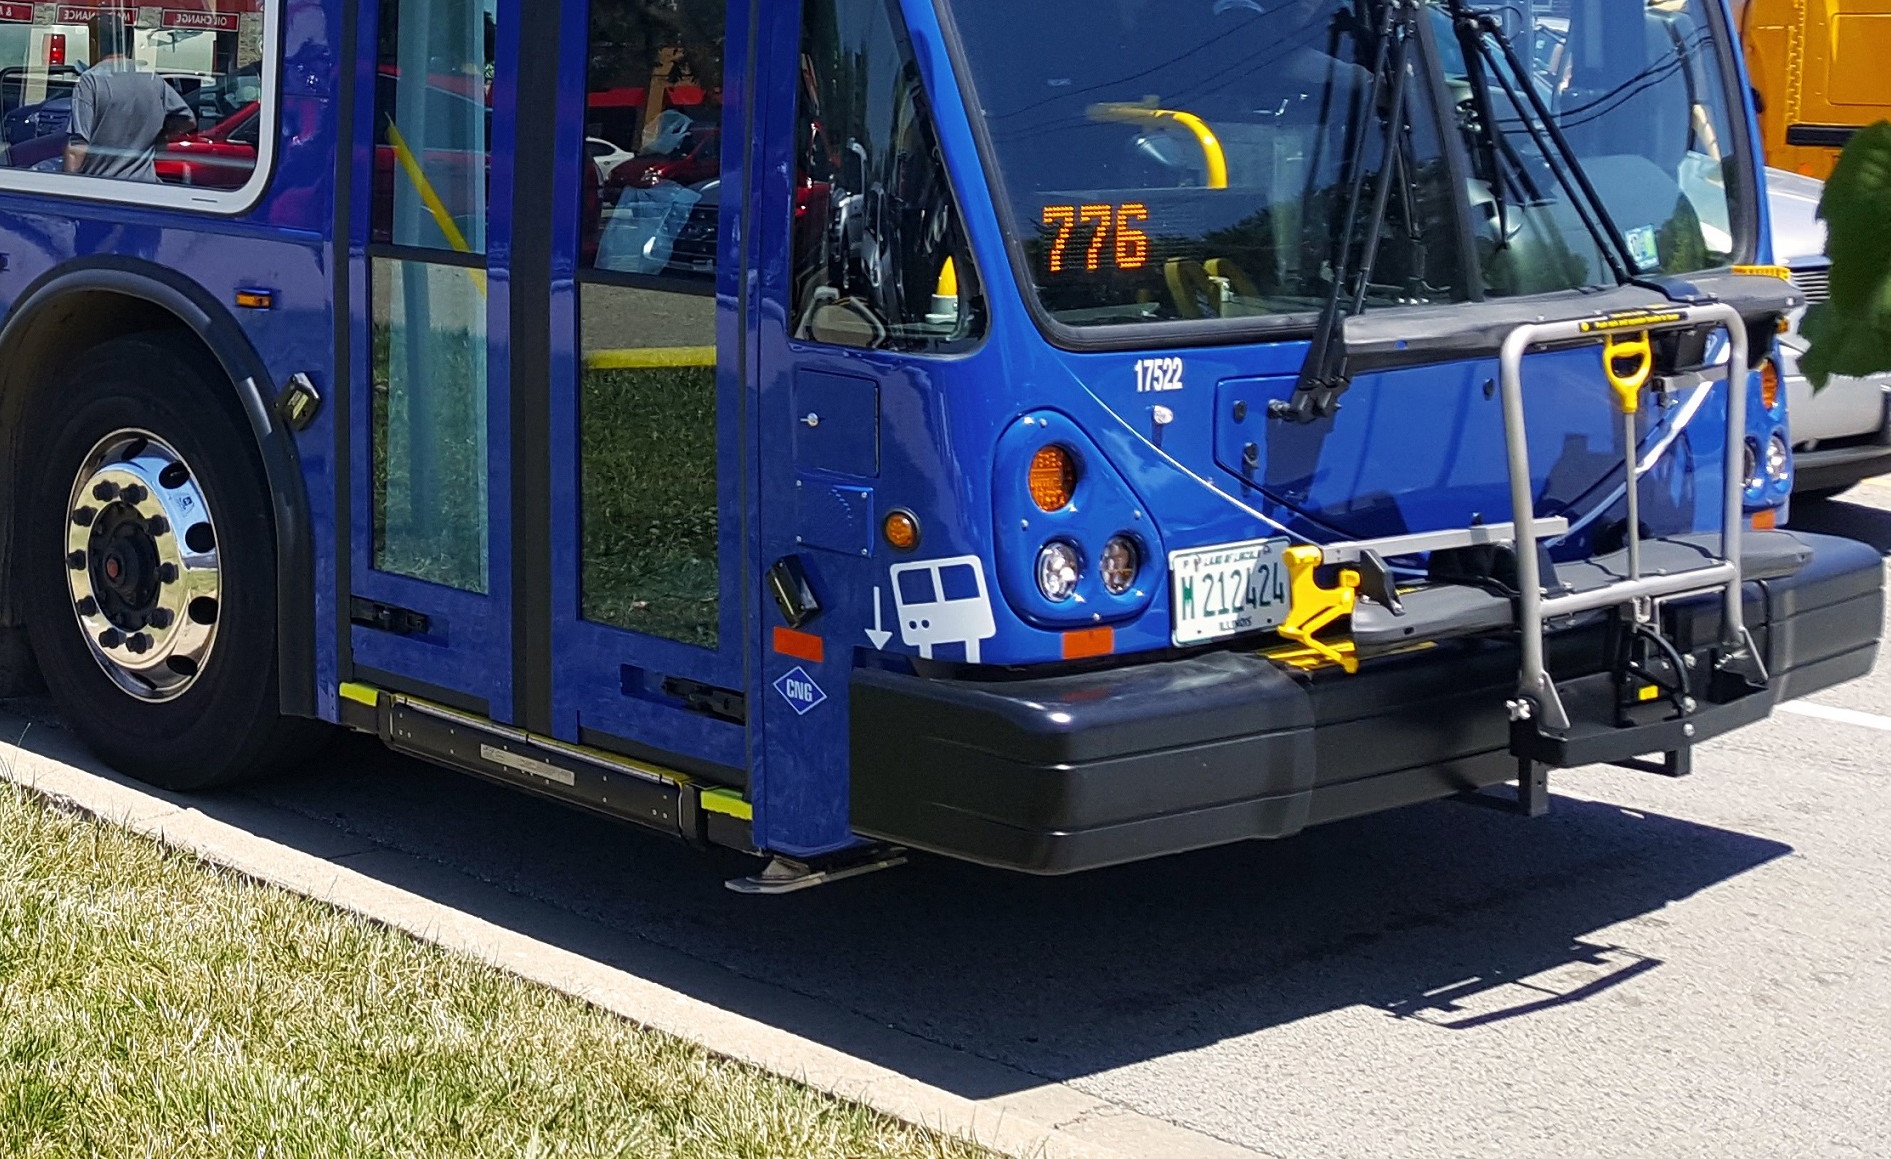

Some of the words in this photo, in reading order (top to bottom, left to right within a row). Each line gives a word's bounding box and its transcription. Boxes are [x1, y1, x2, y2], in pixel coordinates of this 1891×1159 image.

[1043, 203, 1148, 272] 776
[1134, 356, 1184, 393] 17522
[1202, 561, 1285, 618] 212424
[786, 678, 813, 702] CNG
